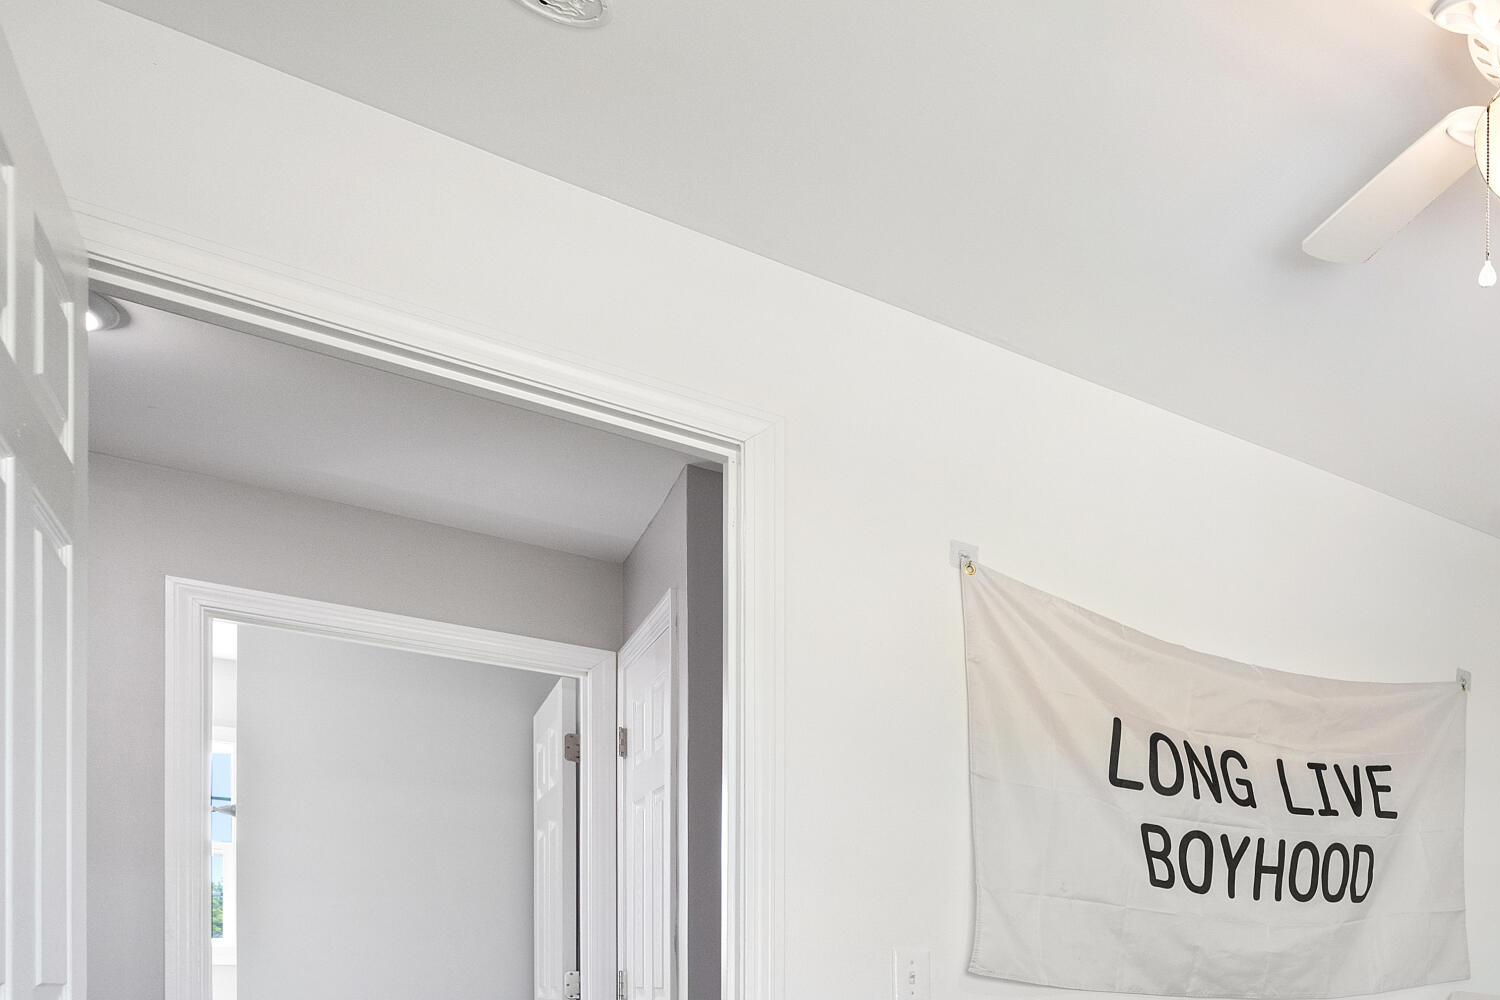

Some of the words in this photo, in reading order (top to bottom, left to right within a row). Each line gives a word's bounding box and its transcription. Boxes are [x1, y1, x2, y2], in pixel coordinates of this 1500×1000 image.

[1108, 717, 1257, 809] LONG
[1276, 757, 1398, 820] LIVE
[1140, 823, 1375, 904] BOYHOOD
